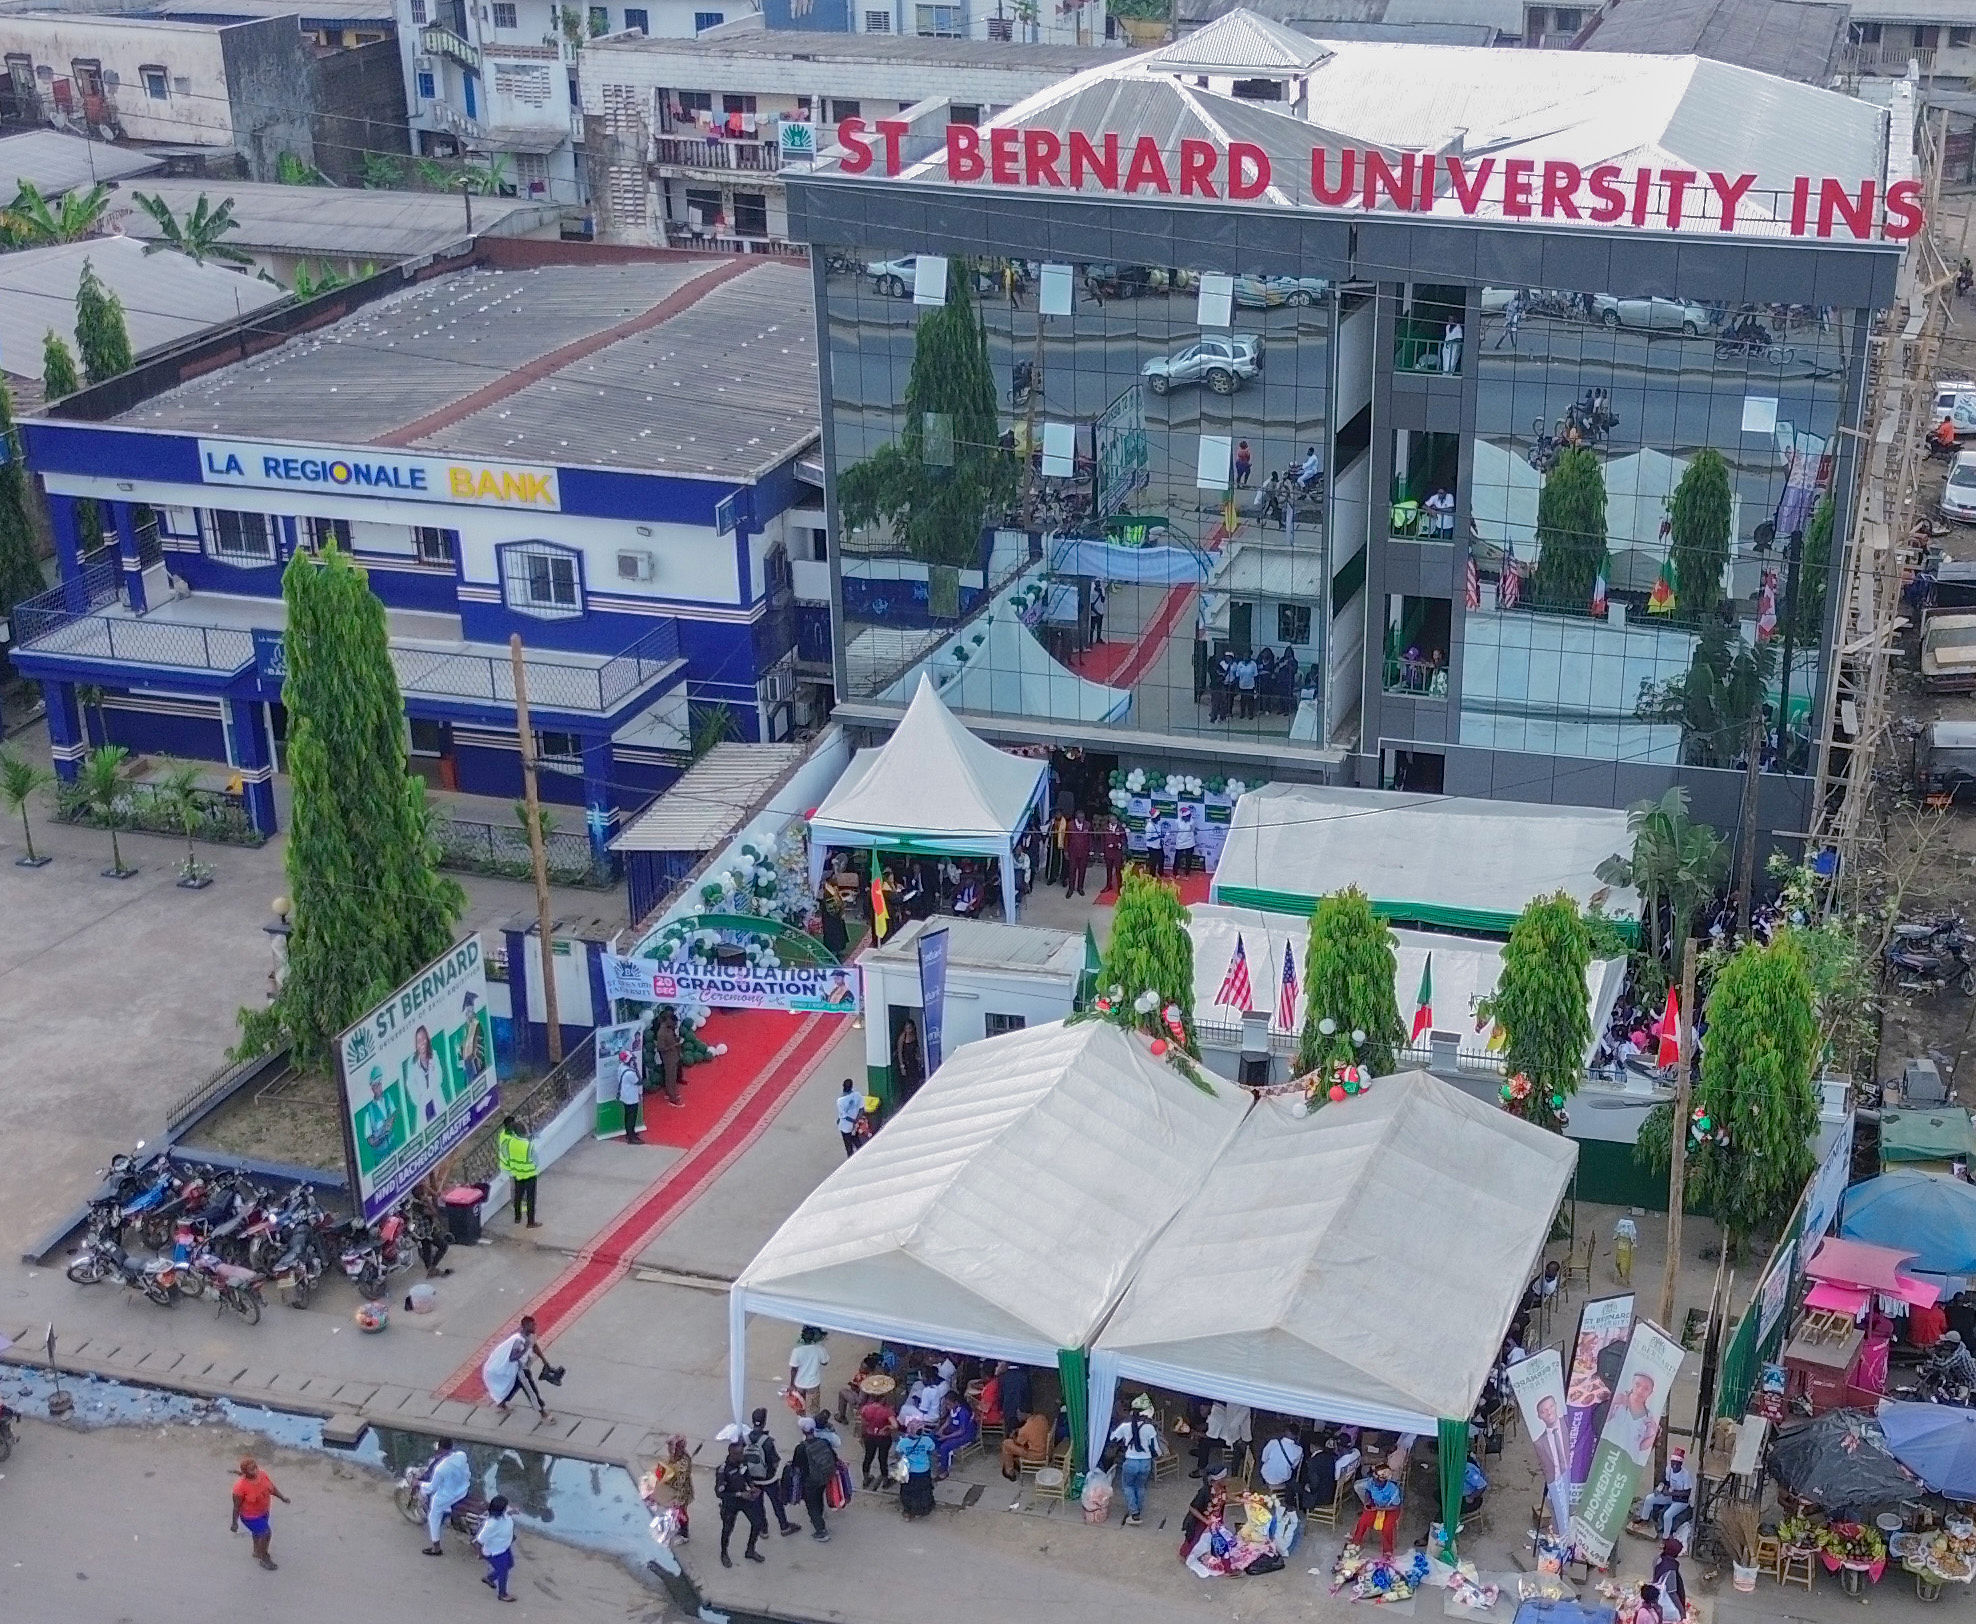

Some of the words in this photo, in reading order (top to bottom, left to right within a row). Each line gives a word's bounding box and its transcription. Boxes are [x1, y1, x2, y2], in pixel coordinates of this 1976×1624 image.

[837, 116, 909, 176] ST
[945, 124, 1272, 200] BERNARD
[1310, 147, 1758, 232] UNIVERSITY
[1790, 175, 1926, 240] INS
[206, 451, 244, 476] LA
[263, 456, 428, 490] REGIONALE
[448, 466, 557, 507] BANK
[376, 1002, 396, 1039] ST
[400, 941, 478, 1019] BERNARD
[656, 978, 673, 987] 20
[656, 986, 675, 995] DEC
[657, 958, 827, 982] MATRICULATION
[676, 977, 817, 997] GRADUATION
[699, 989, 765, 1008] Ceremony
[397, 1140, 440, 1185] BACHELOR
[441, 1111, 472, 1145] MASTER
[1583, 1449, 1621, 1522] BIOMEDICAL
[1595, 1473, 1629, 1532] SCIENCES
